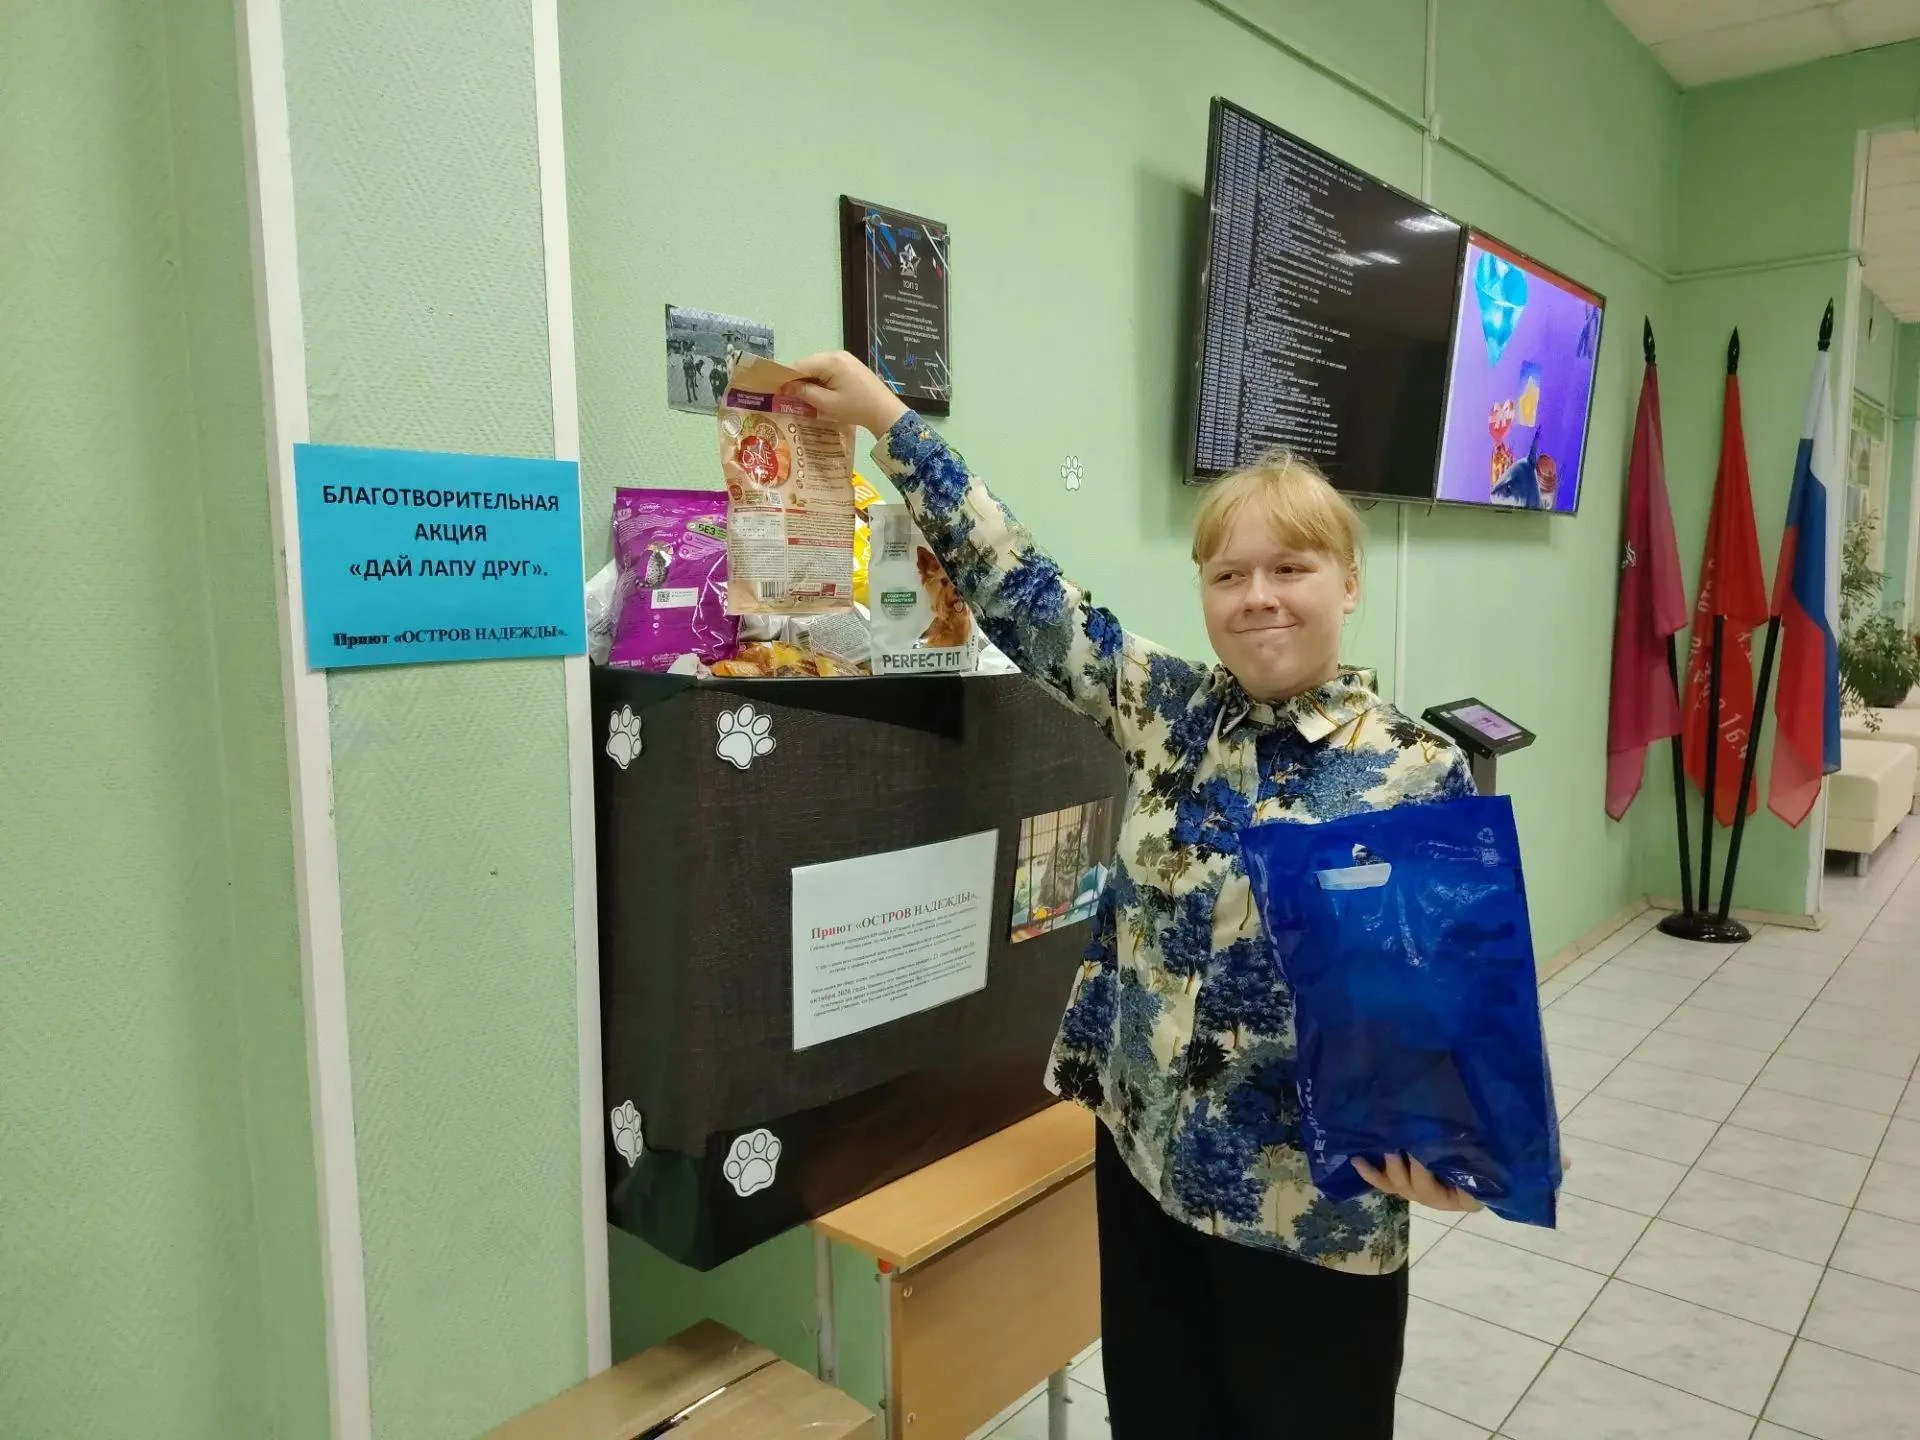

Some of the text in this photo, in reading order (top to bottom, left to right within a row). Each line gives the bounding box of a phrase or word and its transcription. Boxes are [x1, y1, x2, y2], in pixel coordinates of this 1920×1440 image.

[742, 449, 774, 468] ONE
[323, 485, 559, 511] БЛАГОТВОРИТЕЛЬНАЯ
[414, 523, 487, 545] АКЦИЯ
[349, 555, 548, 581] «ДАЙ ЛАПУ ДРУГ».
[333, 625, 568, 649] Приют «ОСТРОВ НАДЕЖДЫ».
[882, 651, 961, 668] PERFECT FIT
[811, 924, 852, 940] Приют
[855, 907, 912, 930] «ОСТРОВ
